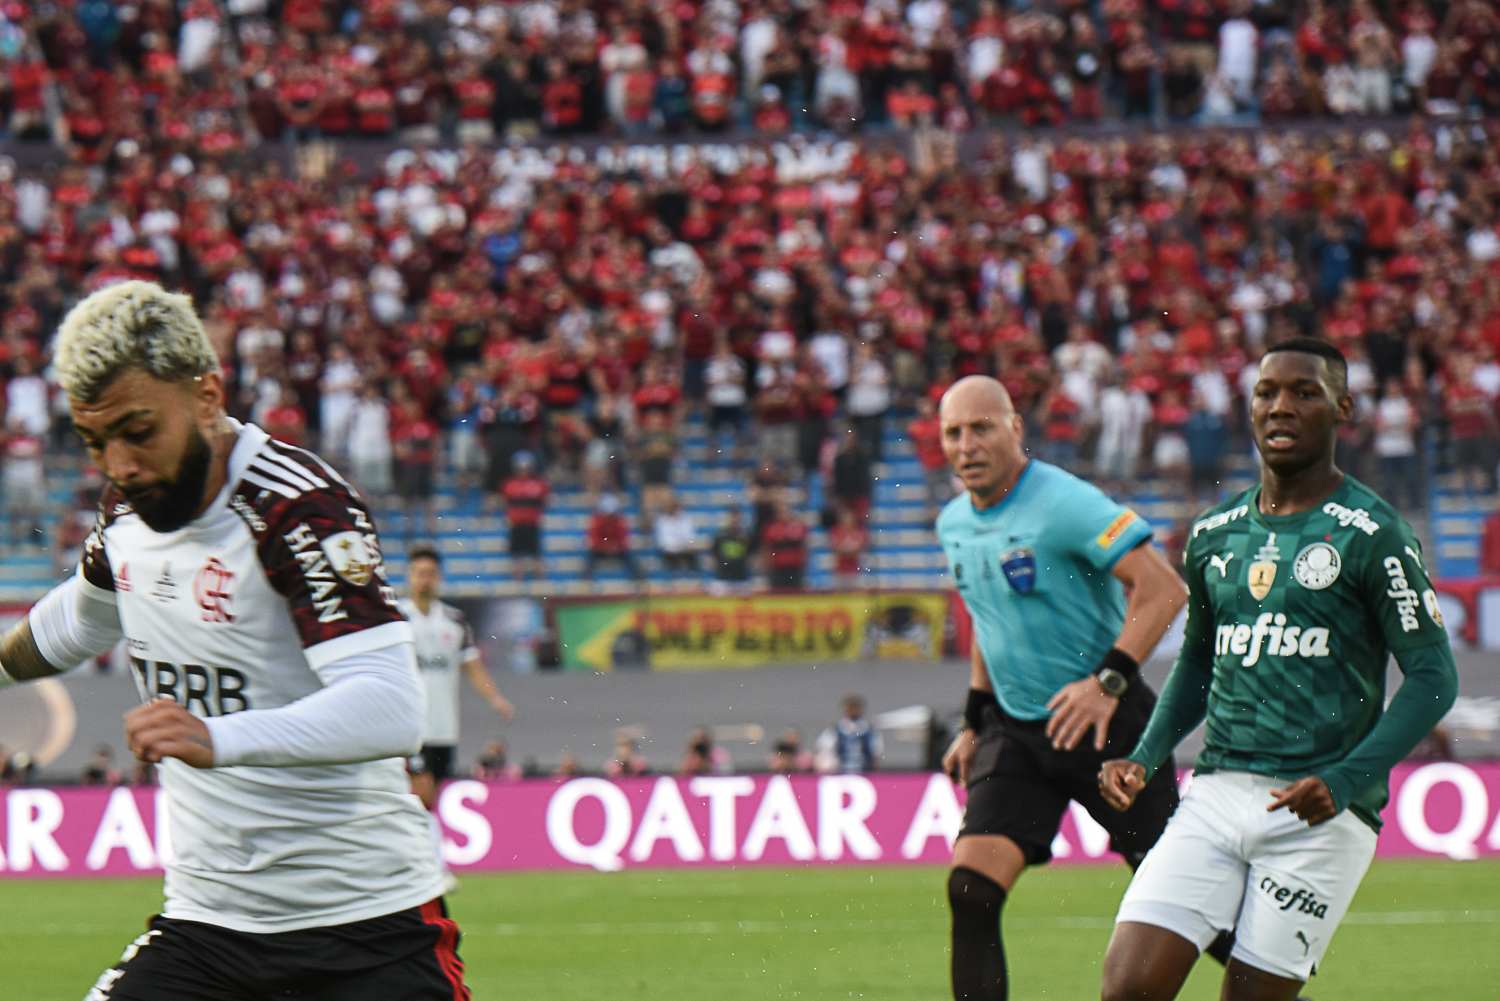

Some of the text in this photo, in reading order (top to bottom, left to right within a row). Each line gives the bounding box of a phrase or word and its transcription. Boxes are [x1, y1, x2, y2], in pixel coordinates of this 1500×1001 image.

[1322, 501, 1380, 536] crefisa
[1382, 555, 1420, 633] crefisa
[155, 659, 249, 720] BRB
[544, 774, 884, 873] QATAR
[1259, 876, 1329, 921] crefisa
